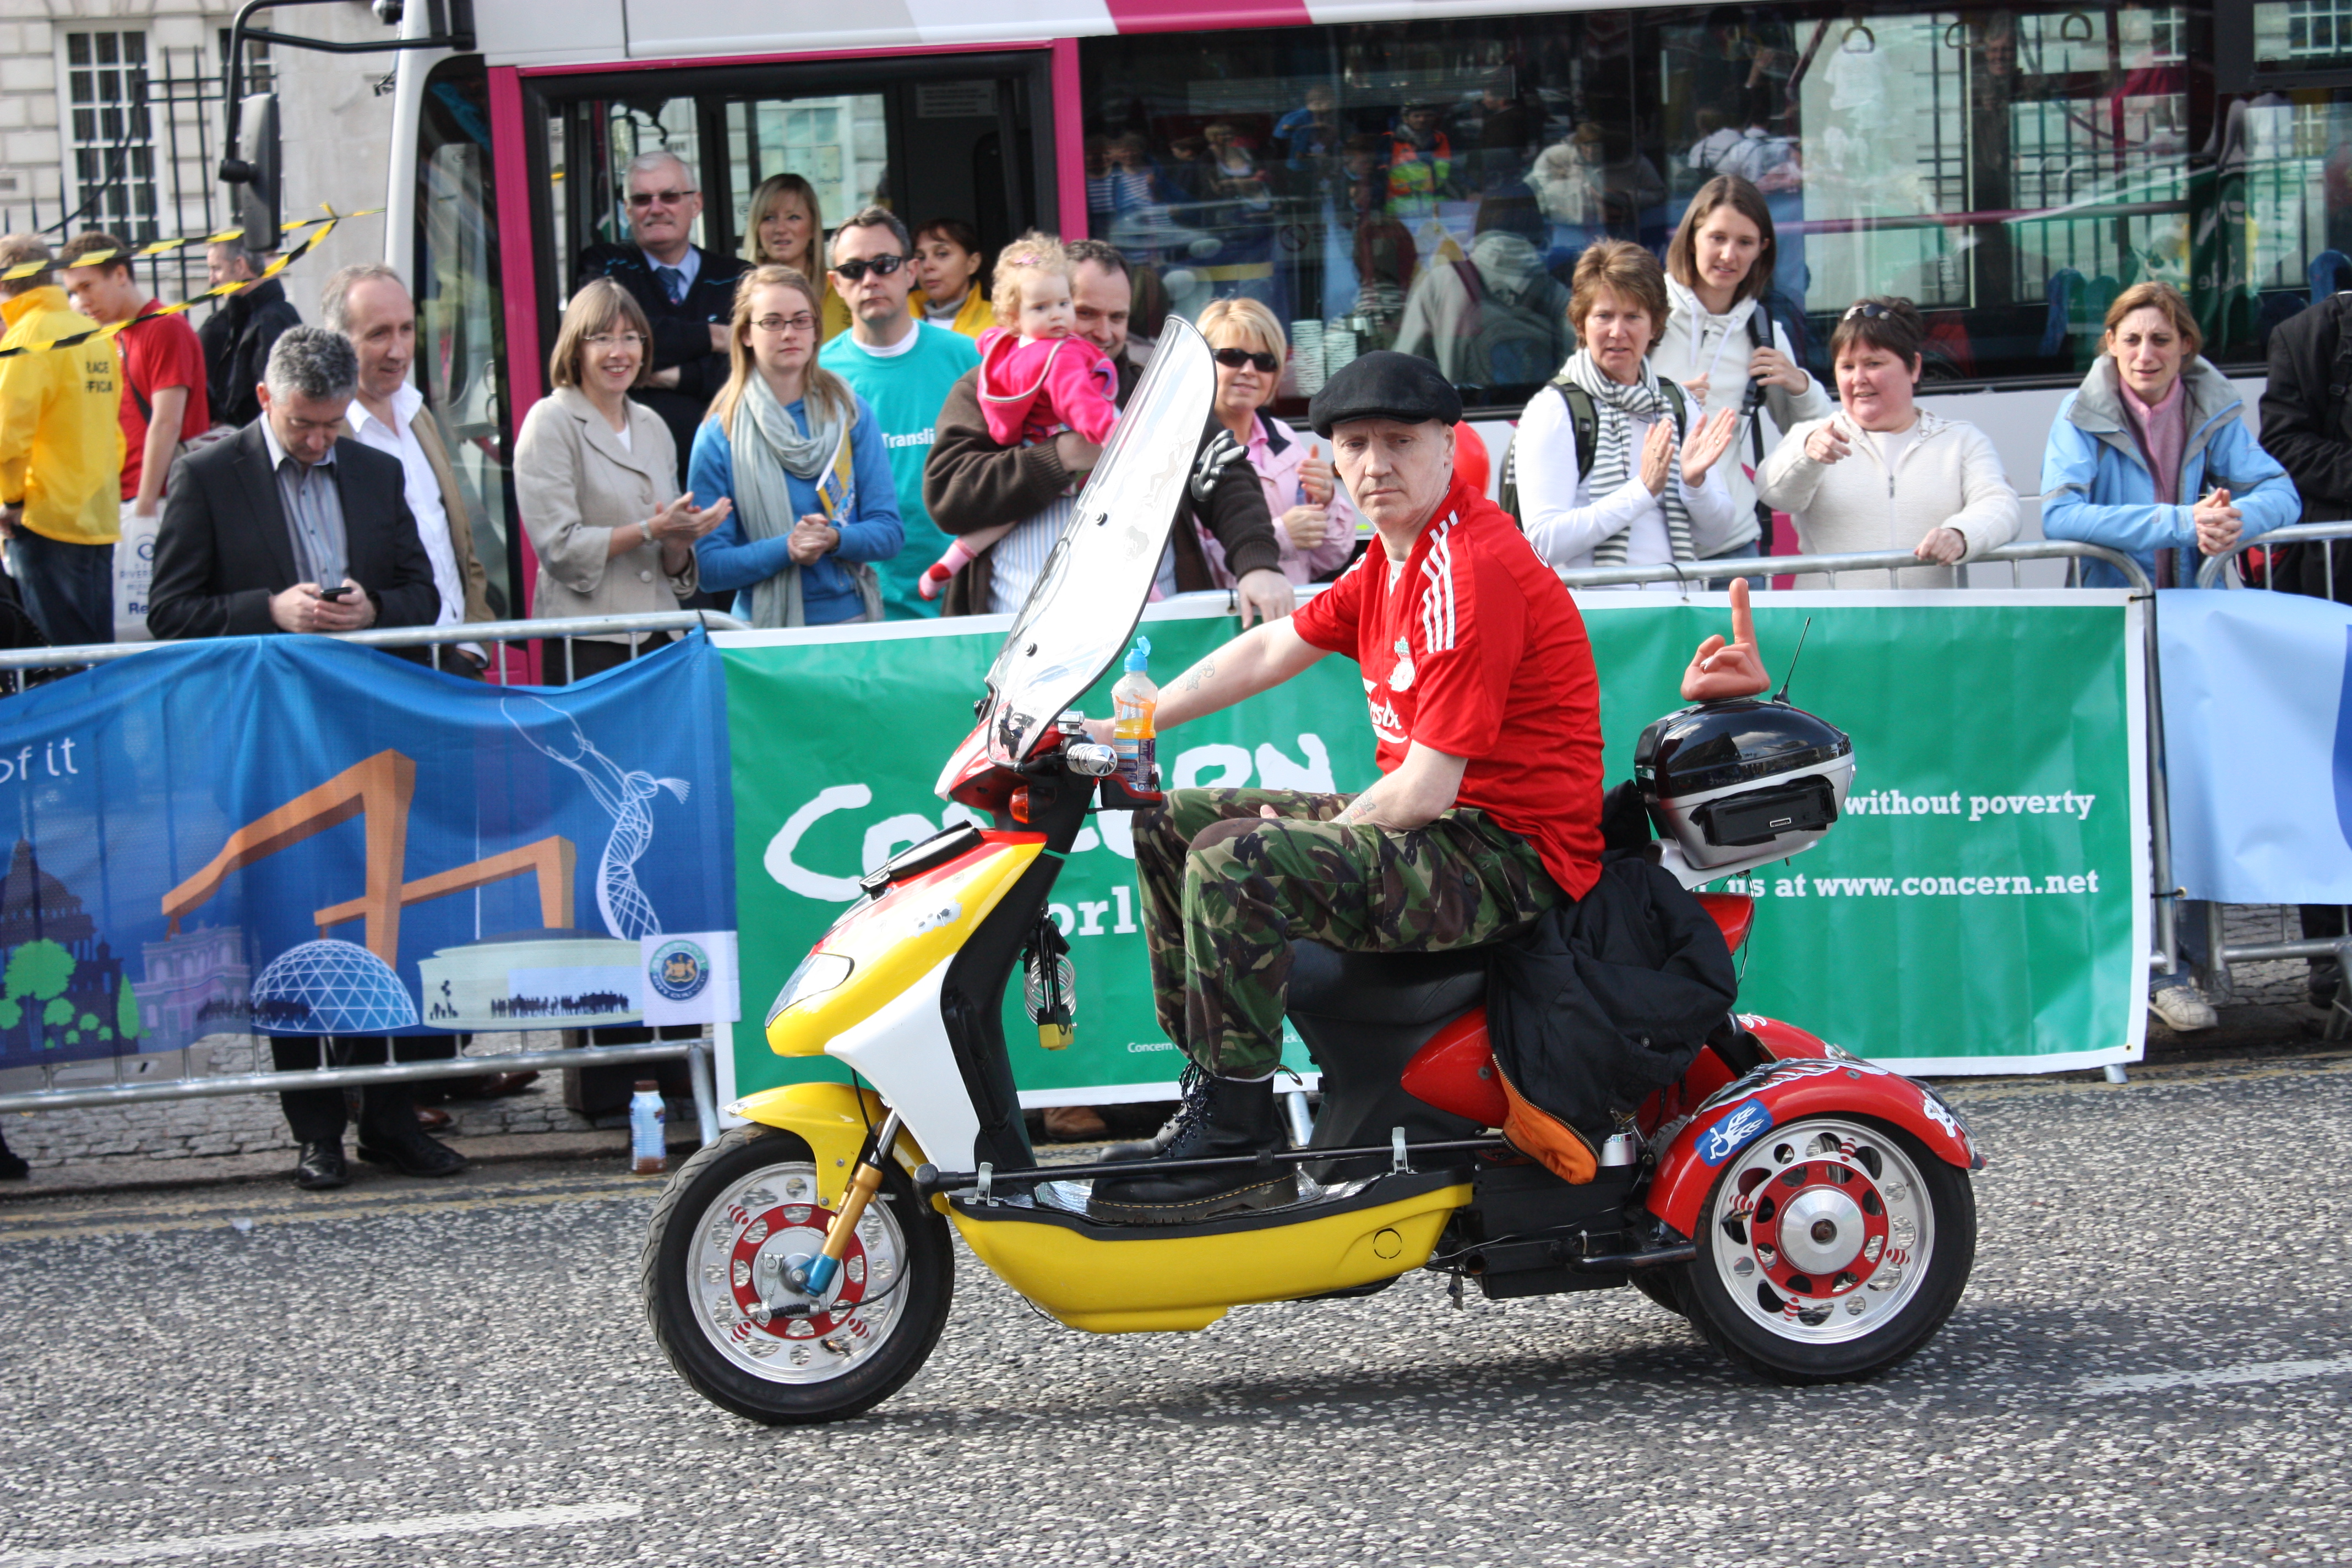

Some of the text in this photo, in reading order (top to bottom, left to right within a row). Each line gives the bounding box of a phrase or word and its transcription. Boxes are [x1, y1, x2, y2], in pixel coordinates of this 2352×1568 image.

[881, 427, 935, 449] Transli
[46, 737, 78, 776] it
[1844, 789, 2095, 821] without poverty
[1726, 878, 1766, 898] us
[1774, 873, 1807, 898] at
[1812, 869, 2099, 897] www.concern.net
[1126, 1042, 1174, 1053] Concern
